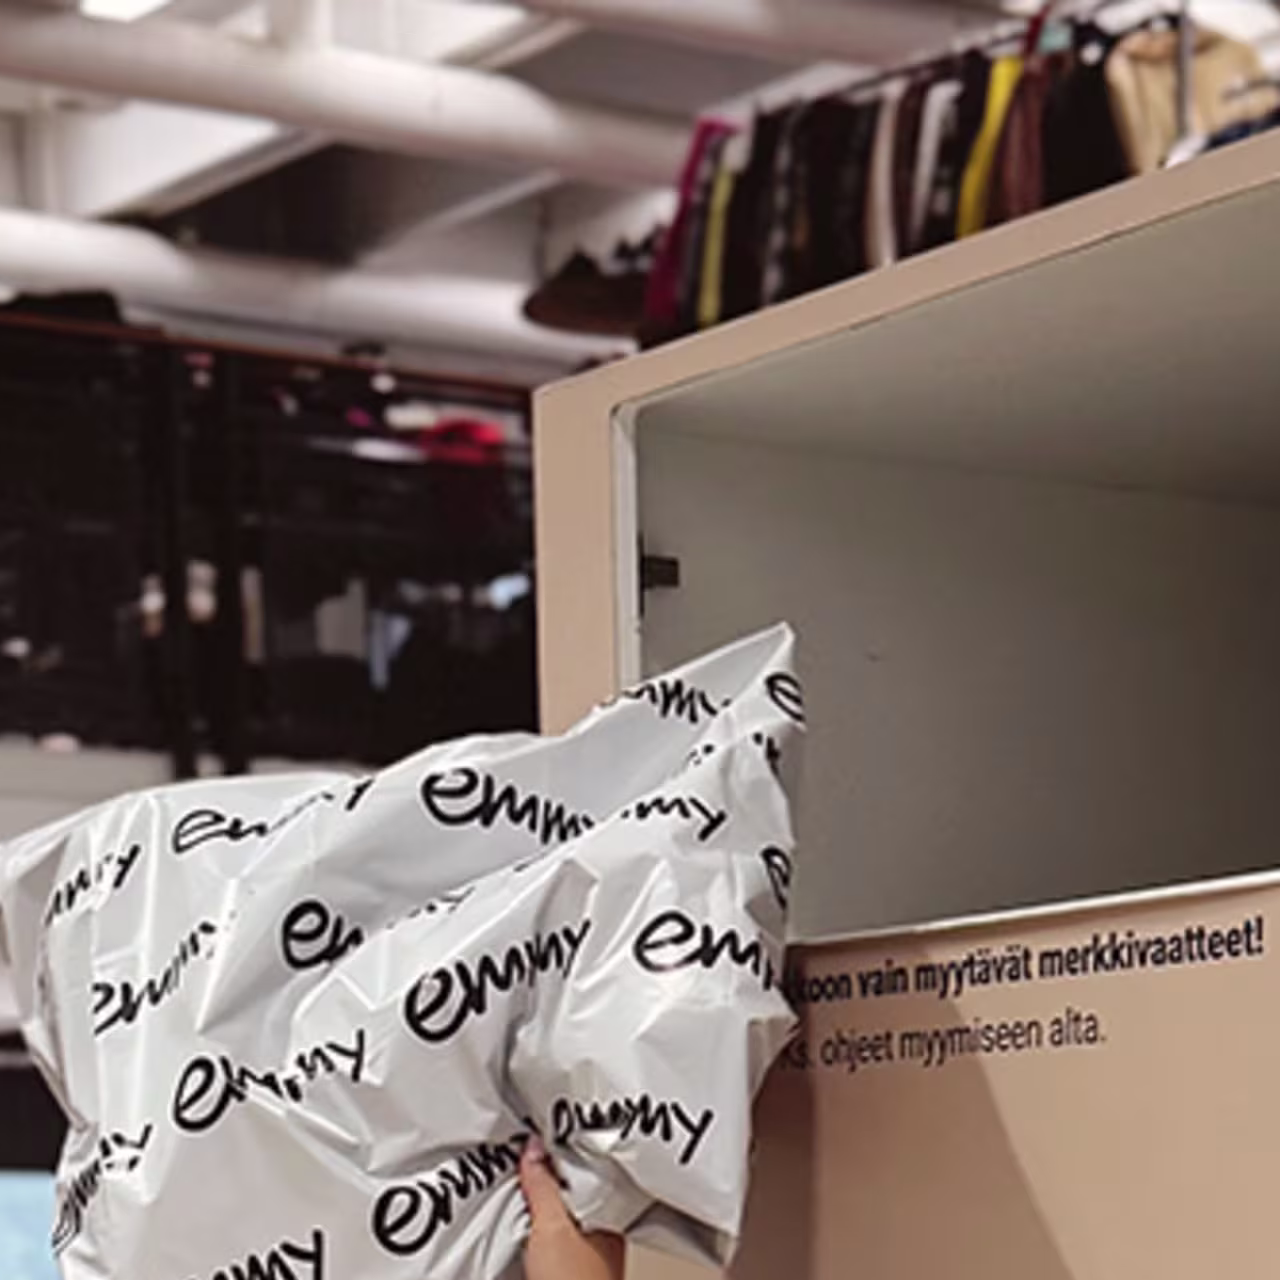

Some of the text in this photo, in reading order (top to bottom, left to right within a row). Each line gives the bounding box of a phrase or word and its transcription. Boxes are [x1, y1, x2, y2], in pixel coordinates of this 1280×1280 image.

[858, 957, 910, 999] vain
[914, 944, 1032, 1000] myytävät
[1037, 916, 1266, 980] merkkivaatteet!
[820, 1028, 894, 1074] ohjeet
[899, 1016, 1043, 1069] myymiseen
[1048, 1009, 1107, 1047] alta.
